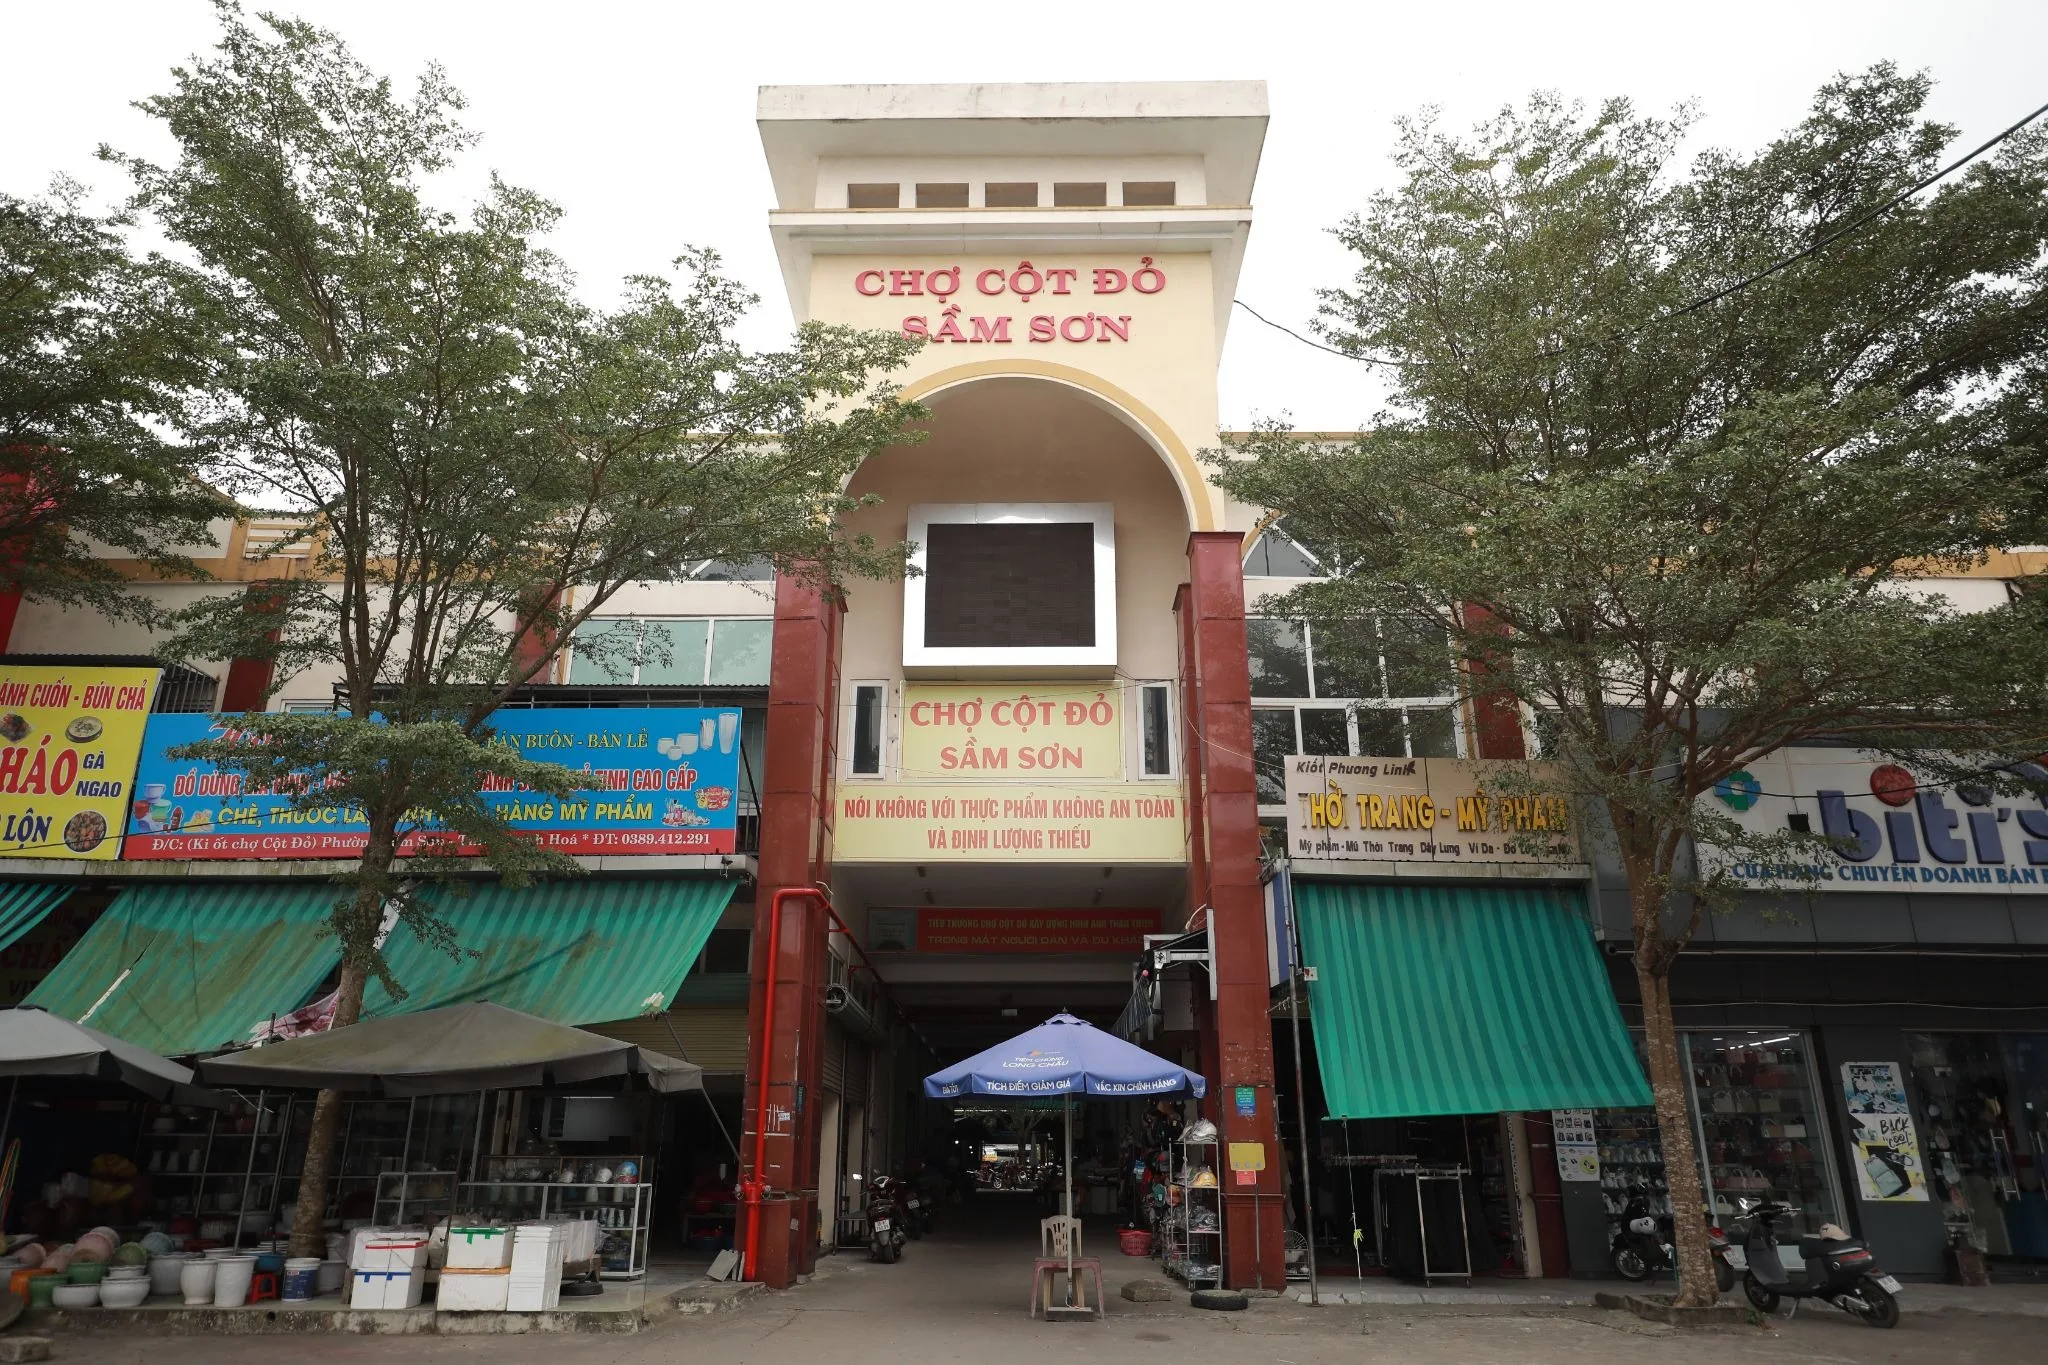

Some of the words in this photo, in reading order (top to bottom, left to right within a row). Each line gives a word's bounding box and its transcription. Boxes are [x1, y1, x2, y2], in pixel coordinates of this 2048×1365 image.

[855, 266, 960, 303] CHỢ
[976, 260, 1077, 303] CỘT
[1092, 256, 1166, 294] ĐỎ
[901, 304, 1013, 343] SẦM
[1029, 312, 1132, 342] SƠN
[29, 676, 72, 708] CUỐN
[82, 681, 116, 709] BÚN
[116, 678, 148, 711] CHẢ
[910, 695, 984, 733] CHỢ
[991, 694, 1056, 733] CỘT
[1063, 693, 1114, 726] ĐỎ
[526, 729, 576, 748] BUÔN
[587, 731, 623, 748] BÁN
[940, 736, 1008, 770] SẦM
[1018, 742, 1083, 769] SƠN
[83, 751, 105, 770] GÀ
[75, 780, 122, 798] NGAO
[173, 767, 196, 796] ĐỒ
[198, 770, 241, 796] DÙNG
[632, 768, 663, 791] CAO
[666, 762, 698, 791] CẤP
[595, 793, 653, 821] PHẨM
[845, 795, 871, 819] NÓI
[875, 795, 927, 819] KHÔNG
[931, 795, 956, 819] VỚI
[960, 798, 999, 823] THỰC
[1003, 792, 1048, 819] PHẨM
[1052, 795, 1105, 819] KHÔNG
[1109, 799, 1130, 819] AN
[1134, 795, 1175, 819] TOÀN
[1356, 793, 1435, 830] TRANG
[3, 807, 53, 850] LỘN
[592, 833, 618, 845] ĐT:
[621, 833, 710, 846] 0389.412.291
[927, 825, 947, 849] VÀ
[951, 829, 988, 854] ĐỊNH
[993, 827, 1043, 854] LƯỢNG
[1047, 823, 1092, 849] THIẾU
[152, 838, 183, 851] Đ/C:
[232, 838, 259, 853] chợ
[262, 837, 288, 853] Cột
[1388, 842, 1414, 855] Trang
[1838, 862, 1917, 883] CHUYÊN
[1920, 866, 1992, 883] DOANH
[1995, 864, 2038, 884] BÁN
[987, 1079, 1007, 1091] TÍCH
[1113, 1082, 1126, 1091] XIN
[1127, 1080, 1151, 1091] CHÍNH
